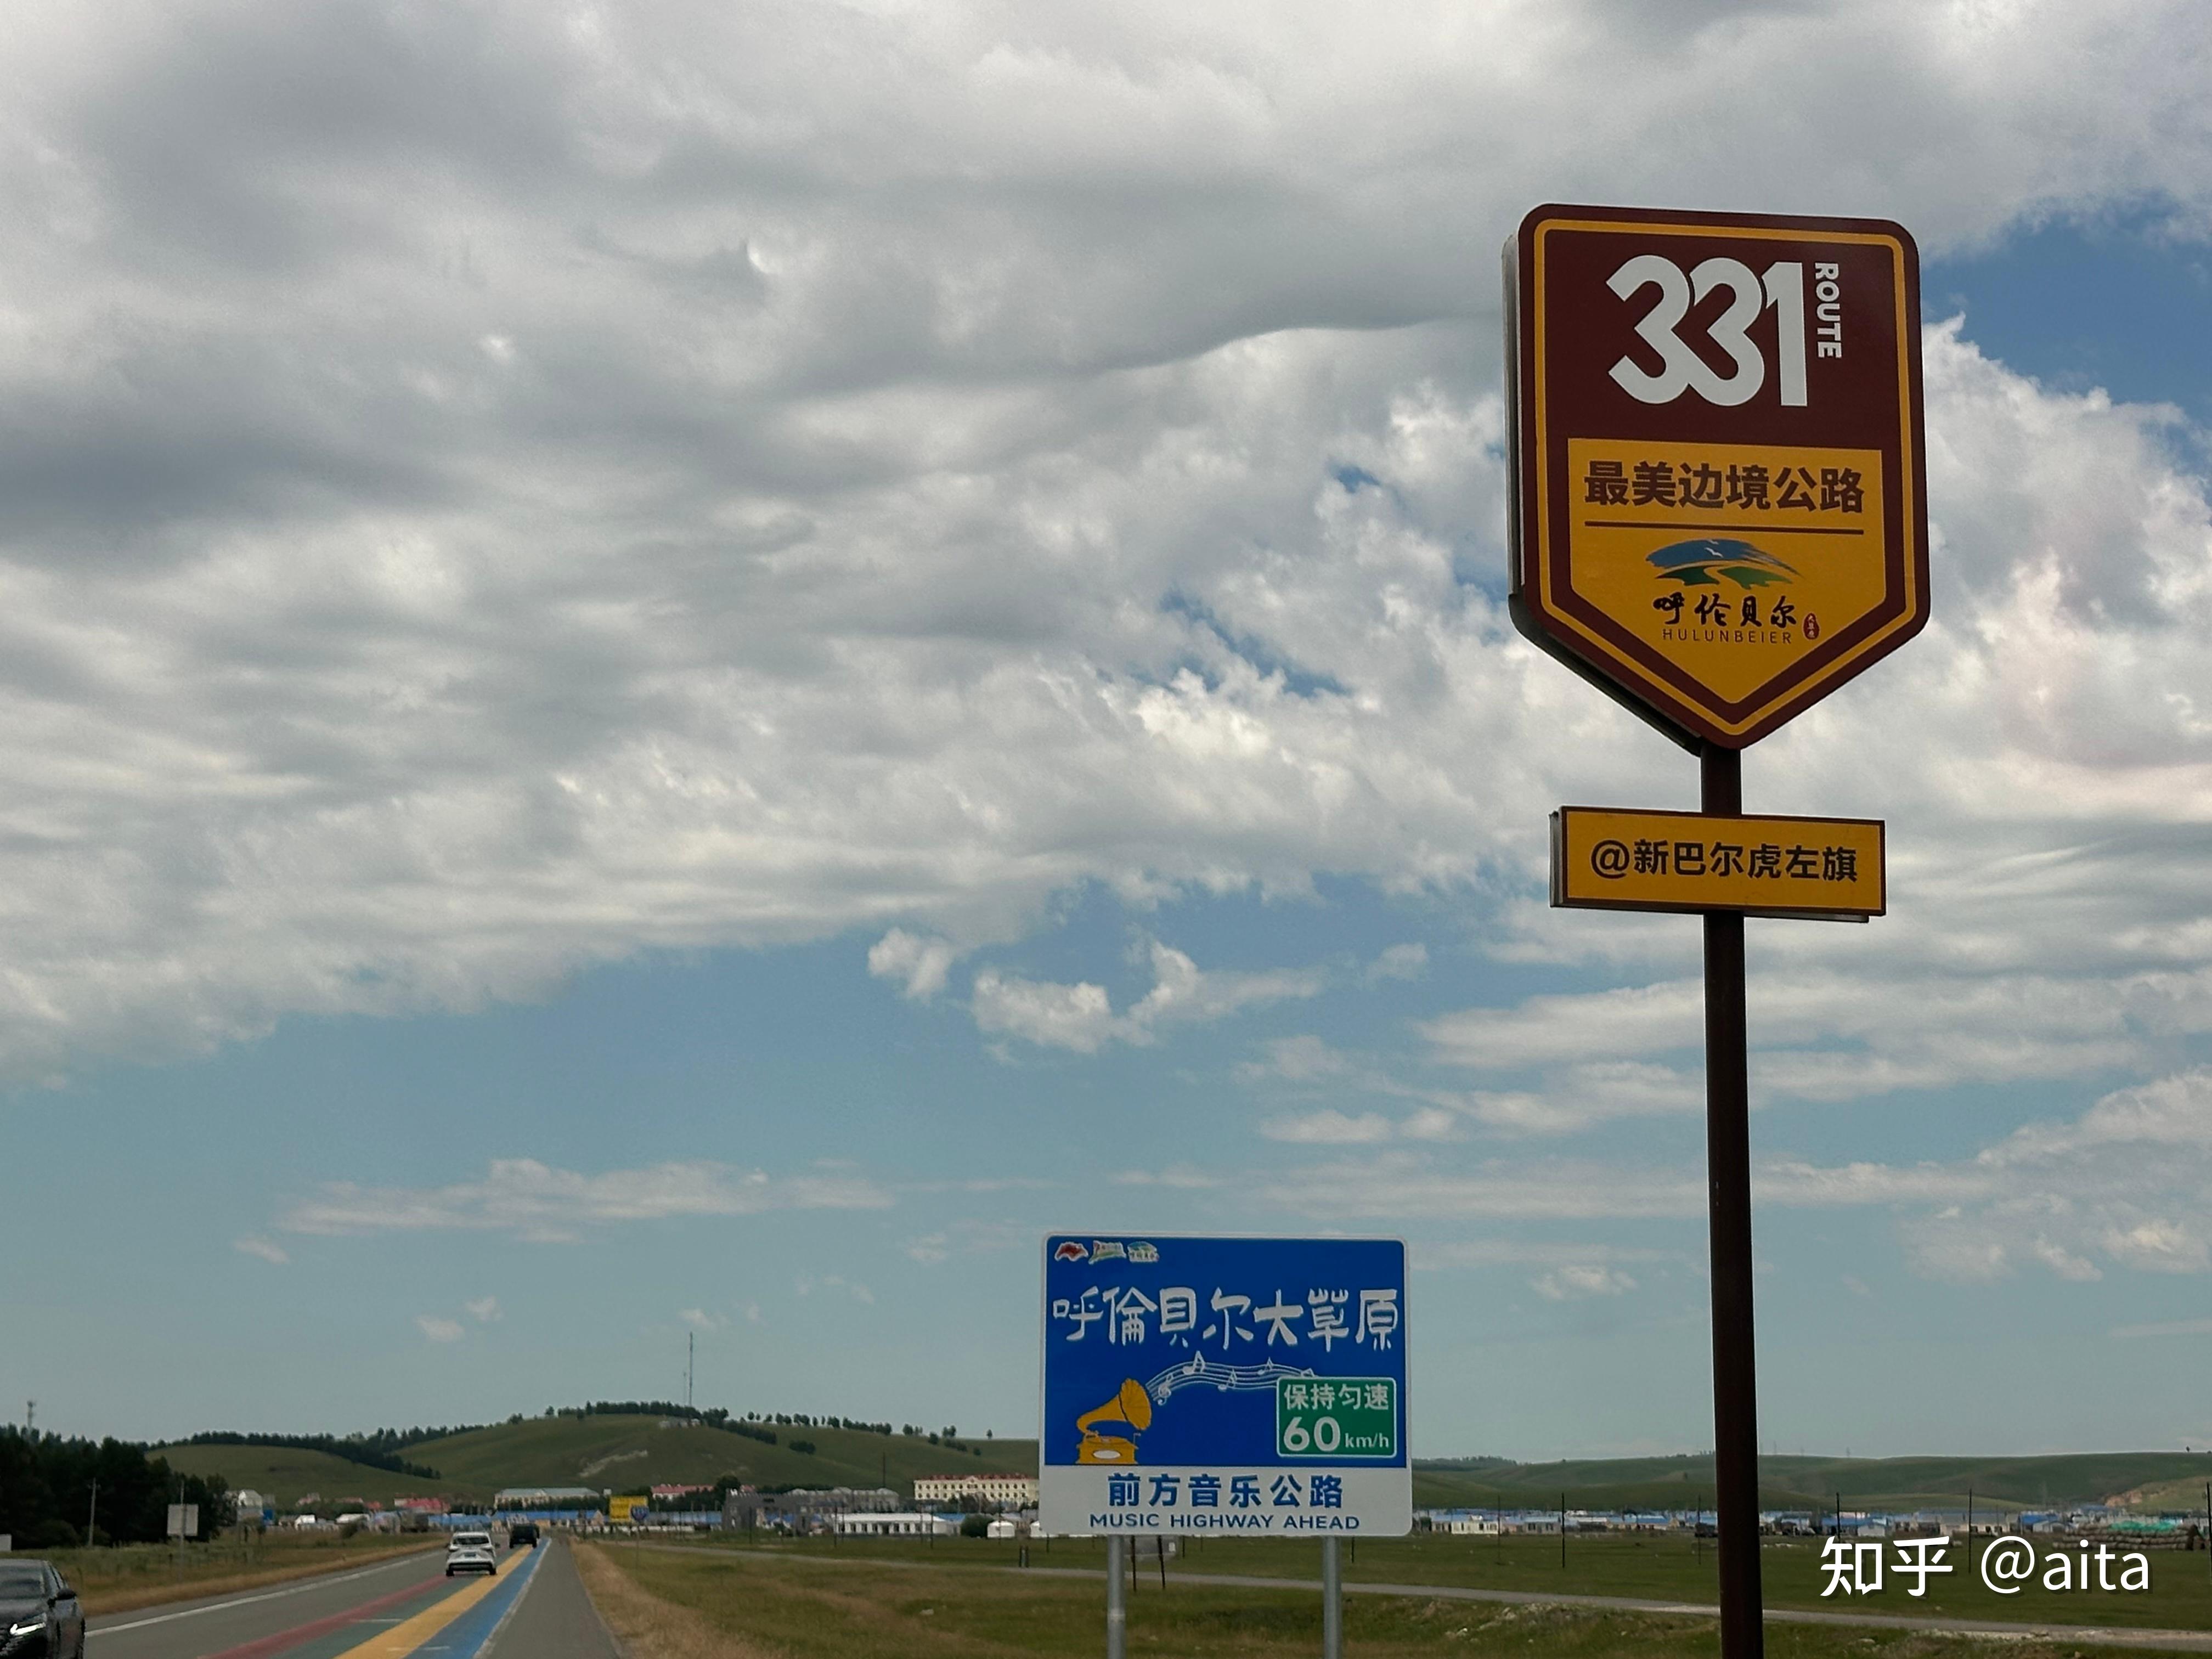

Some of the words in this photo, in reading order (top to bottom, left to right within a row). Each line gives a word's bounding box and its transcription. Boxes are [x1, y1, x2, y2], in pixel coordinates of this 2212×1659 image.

[1814, 262, 1842, 359] ROUTE
[1606, 255, 1808, 407] 331
[1583, 460, 1865, 514] 最美边境公路
[1653, 592, 1797, 628] 呼伦贝尔
[1663, 629, 1792, 644] HULUNBEIER
[1590, 838, 1858, 883] @新巴尔虎左旗
[1284, 1383, 1389, 1410] 保持匀速
[1107, 1473, 1343, 1509] 前方音乐公路
[1090, 1513, 1160, 1527] MUSIC
[1170, 1514, 1274, 1528] HIGHWAY
[1283, 1515, 1360, 1530] AHEAD
